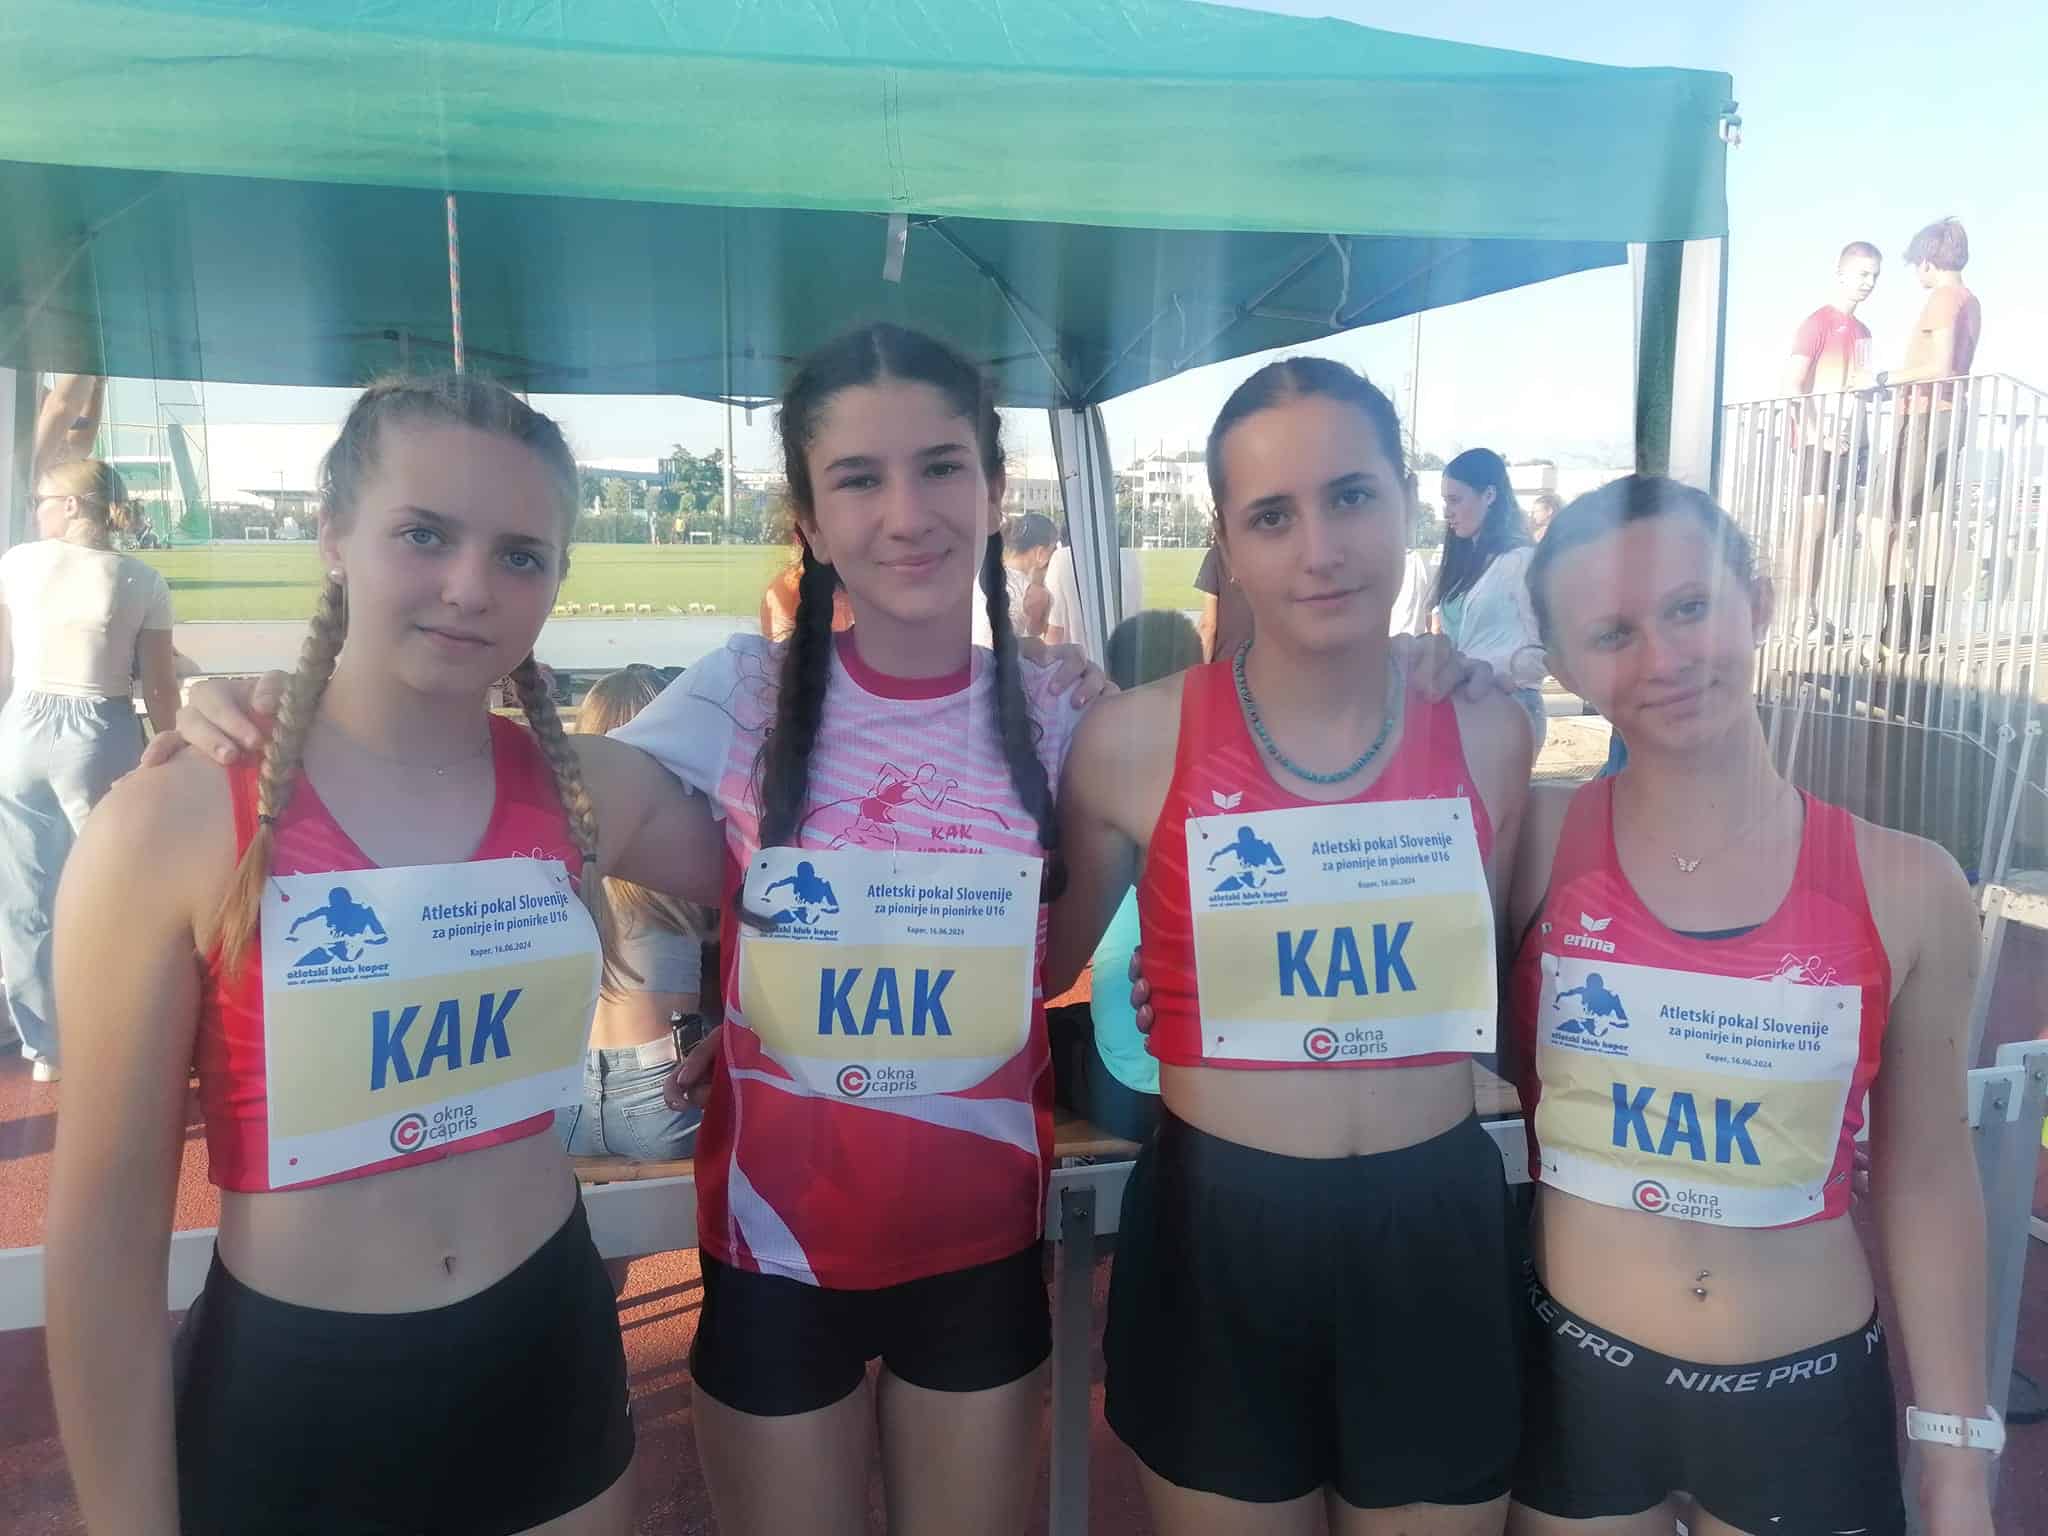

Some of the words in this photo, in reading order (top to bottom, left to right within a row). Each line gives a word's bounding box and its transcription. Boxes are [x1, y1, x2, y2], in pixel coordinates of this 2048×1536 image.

[931, 824, 973, 840] KAK
[1311, 838, 1361, 855] Atletski
[1364, 835, 1398, 854] pokal
[1399, 833, 1453, 849] Slovenije
[1322, 862, 1334, 871] za
[1336, 857, 1376, 872] pionirje
[1378, 856, 1388, 867] in
[1390, 853, 1430, 868] pionirke
[1431, 851, 1450, 862] U16
[867, 884, 916, 899] Atletski
[919, 886, 953, 901] pokal
[956, 887, 1013, 903] Slovenije
[421, 900, 478, 921] Atletski
[481, 896, 516, 918] pokal
[519, 891, 569, 910] Slovenije
[874, 905, 886, 914] za
[888, 902, 928, 917] pionirje
[930, 904, 940, 915] in
[942, 905, 984, 918] pionirke
[985, 906, 1005, 916] U16
[432, 928, 446, 939] za
[448, 921, 491, 940] pionirje
[494, 920, 505, 931] in
[506, 913, 548, 932] pionirke
[550, 910, 568, 923] U16
[1564, 934, 1616, 954] erima
[1276, 921, 1417, 997] KAK
[818, 967, 956, 1036] KAK
[1660, 1004, 1714, 1025] Atletski
[1718, 1013, 1758, 1030] pokal
[1762, 1018, 1829, 1038] Slovenije
[370, 988, 523, 1091] KAK
[1344, 1028, 1384, 1042] okna
[1669, 1026, 1681, 1037] za
[1684, 1027, 1729, 1045] pionirje
[1732, 1032, 1743, 1045] in
[1745, 1035, 1795, 1051] pionirke
[1798, 1039, 1821, 1052] U16
[1341, 1041, 1388, 1056] capris
[876, 1066, 914, 1080] okna
[872, 1080, 917, 1094] capris
[433, 1104, 474, 1123] okna
[1611, 1082, 1761, 1166] KAK
[429, 1117, 478, 1139] capris
[1676, 1188, 1719, 1206] okna
[1671, 1203, 1722, 1218] capris
[1556, 1320, 1634, 1367] PRO
[1664, 1367, 1762, 1393] NIKE
[1765, 1352, 1839, 1389] PRO
